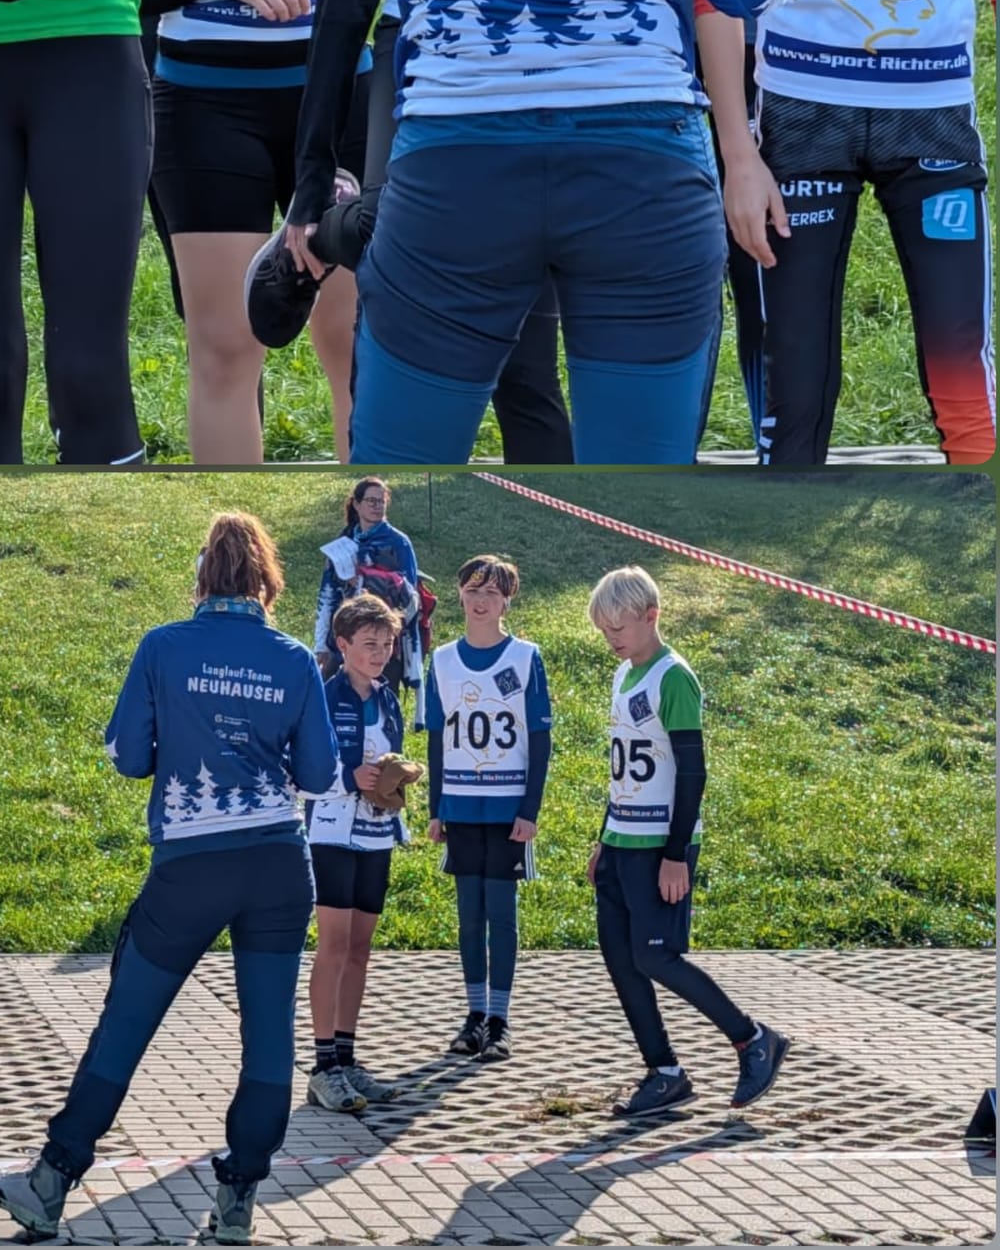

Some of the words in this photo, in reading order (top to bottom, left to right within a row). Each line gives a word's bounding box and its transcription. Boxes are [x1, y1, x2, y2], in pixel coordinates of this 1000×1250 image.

[206, 4, 264, 19] www.Sp
[767, 44, 877, 69] www.Sport
[879, 53, 968, 71] Richter.de
[780, 180, 843, 198] ÜRTH
[787, 207, 835, 227] TERREX
[202, 661, 272, 683] Langlauf-Team
[187, 676, 285, 704] NEUHAUSEN
[446, 710, 517, 750] 103
[611, 736, 656, 783] 05
